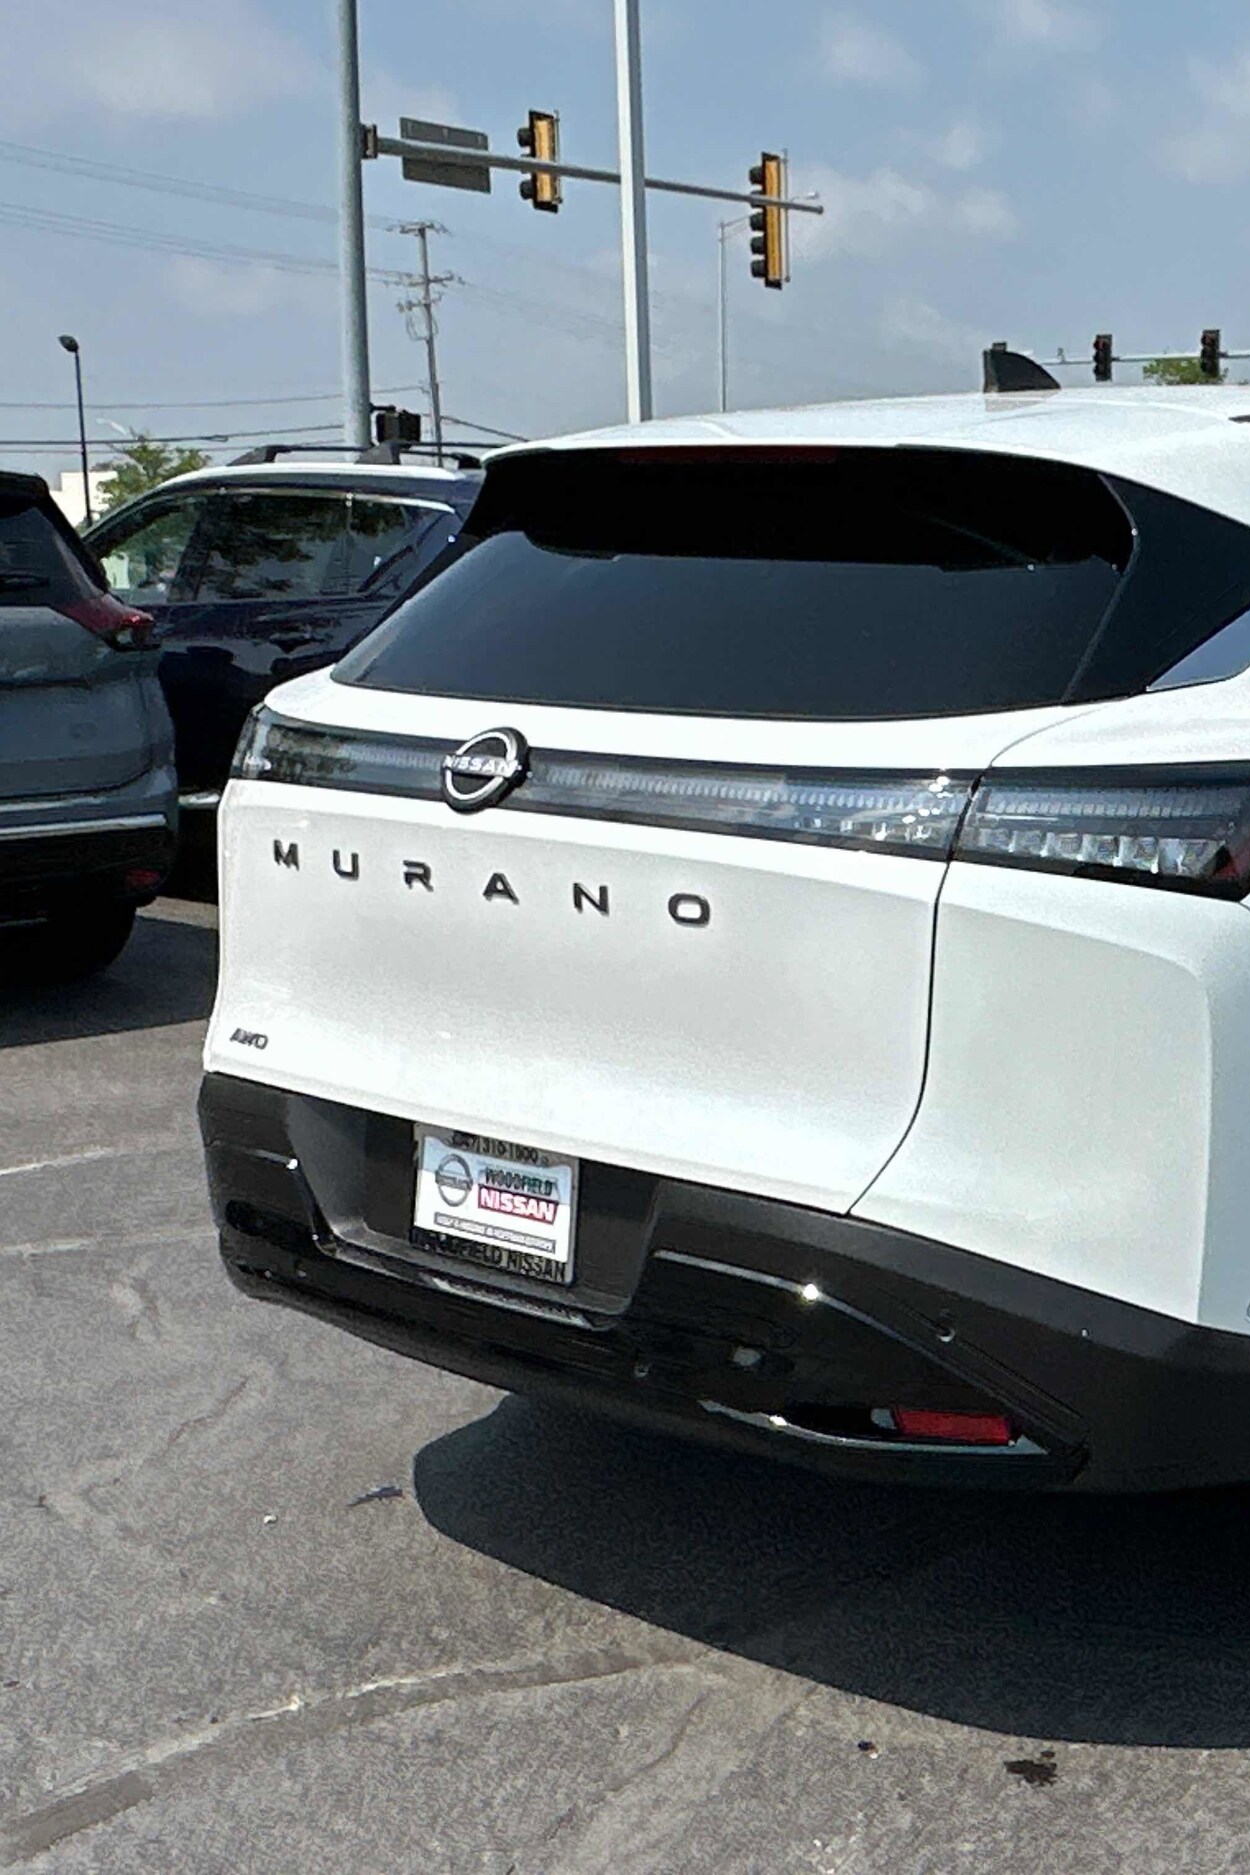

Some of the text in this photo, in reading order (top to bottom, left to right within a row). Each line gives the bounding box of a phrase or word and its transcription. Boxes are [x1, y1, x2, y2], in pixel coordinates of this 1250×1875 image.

[442, 754, 519, 778] NISSAN
[273, 839, 712, 928] MURANO
[230, 1027, 269, 1050] AWD
[480, 1187, 556, 1222] NISSAN
